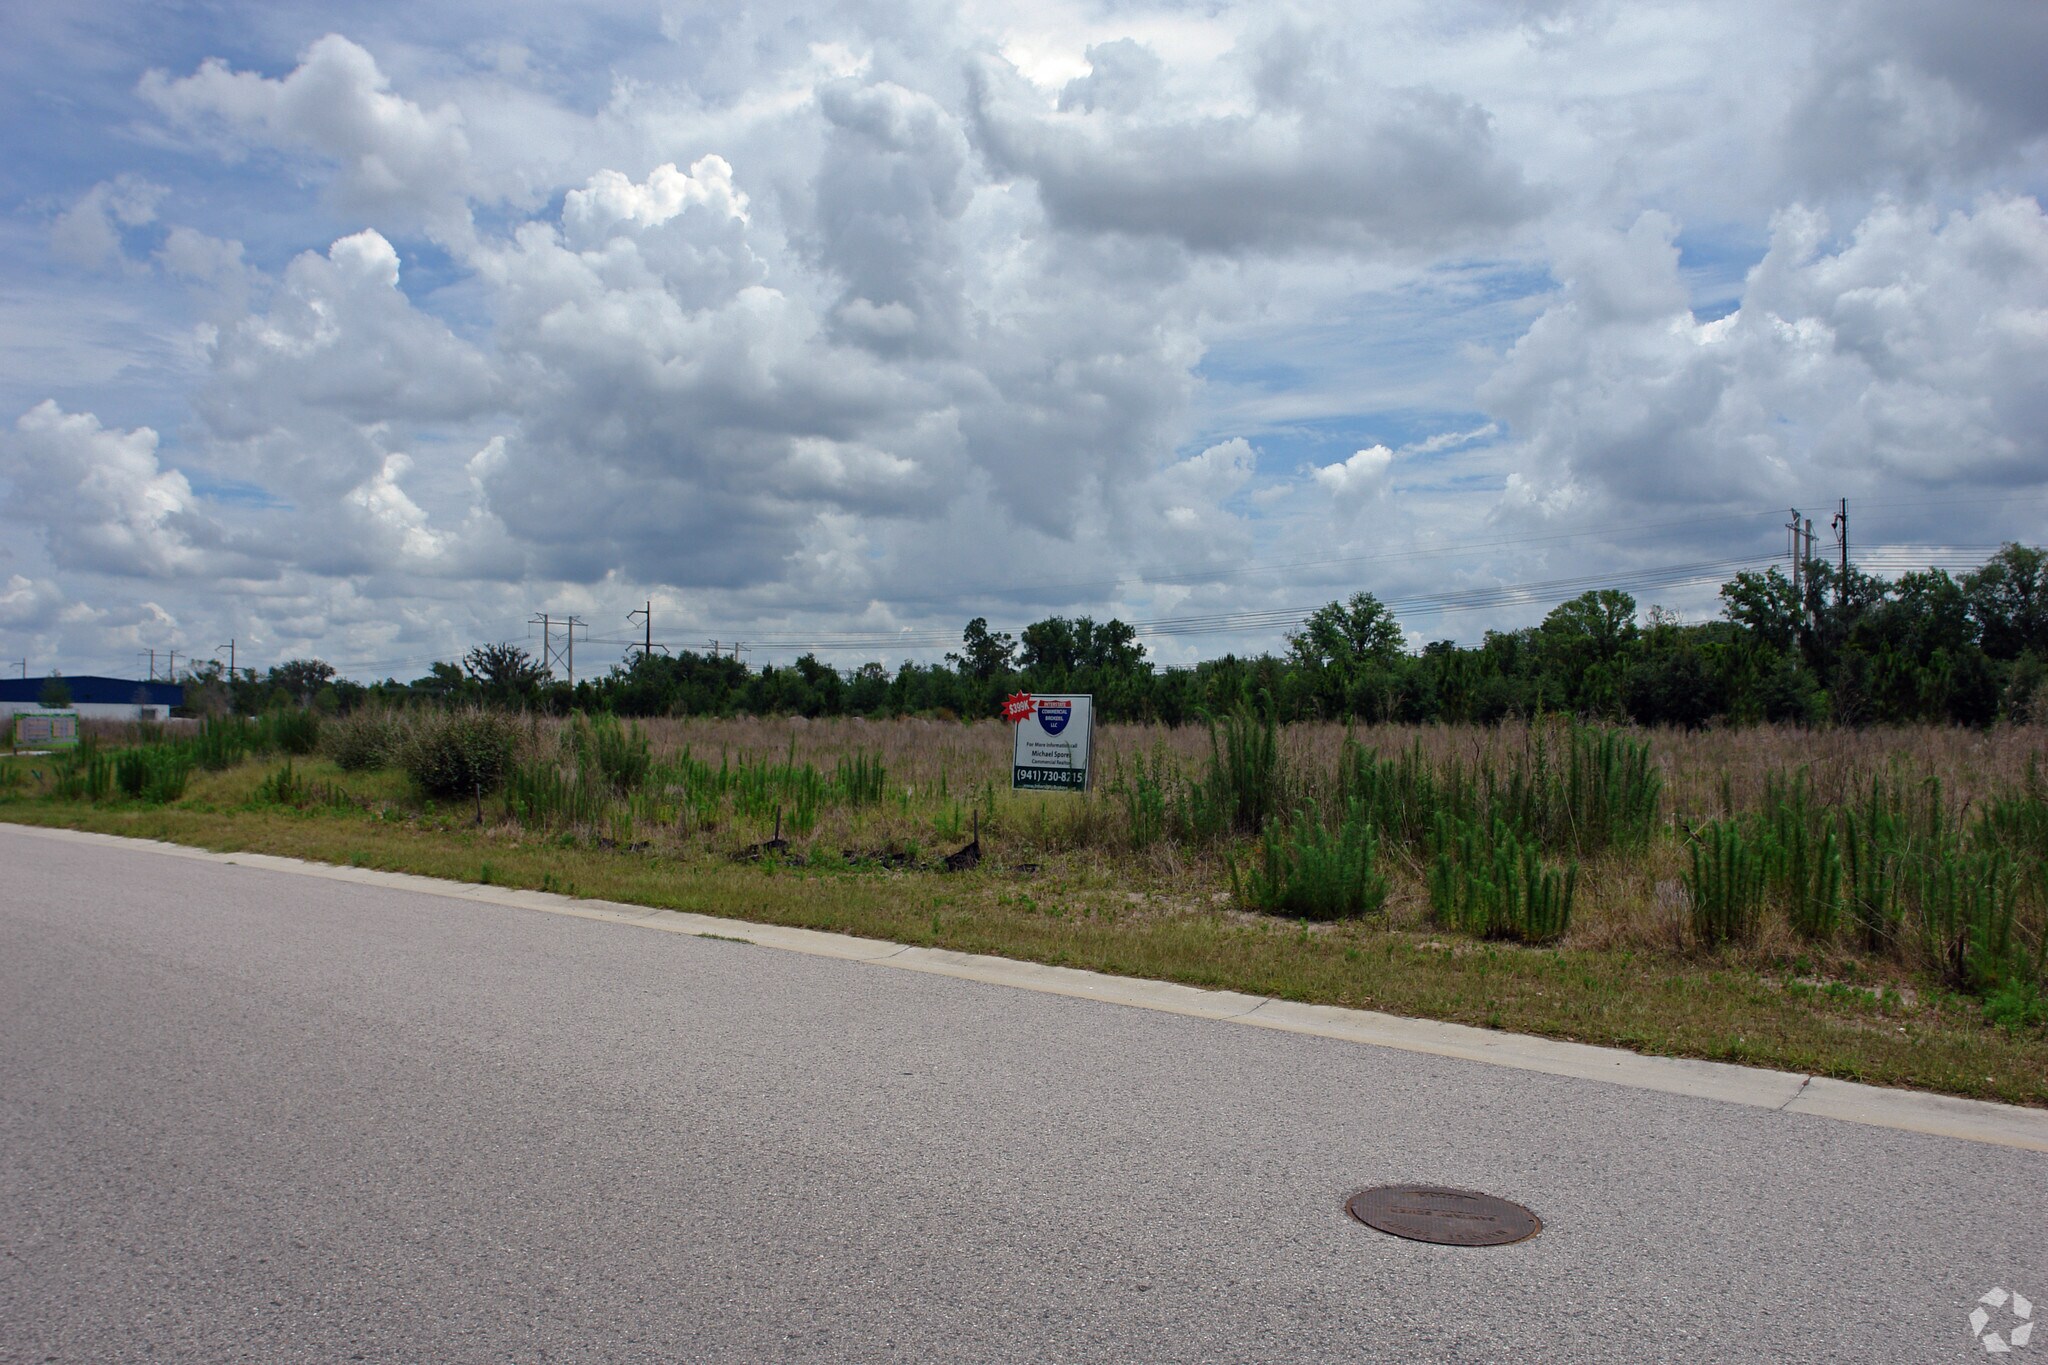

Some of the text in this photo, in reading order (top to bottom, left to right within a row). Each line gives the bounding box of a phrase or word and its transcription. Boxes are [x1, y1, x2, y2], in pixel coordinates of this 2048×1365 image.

[1009, 700, 1030, 715] $399K
[1017, 769, 1083, 783] (941) 730-8215
